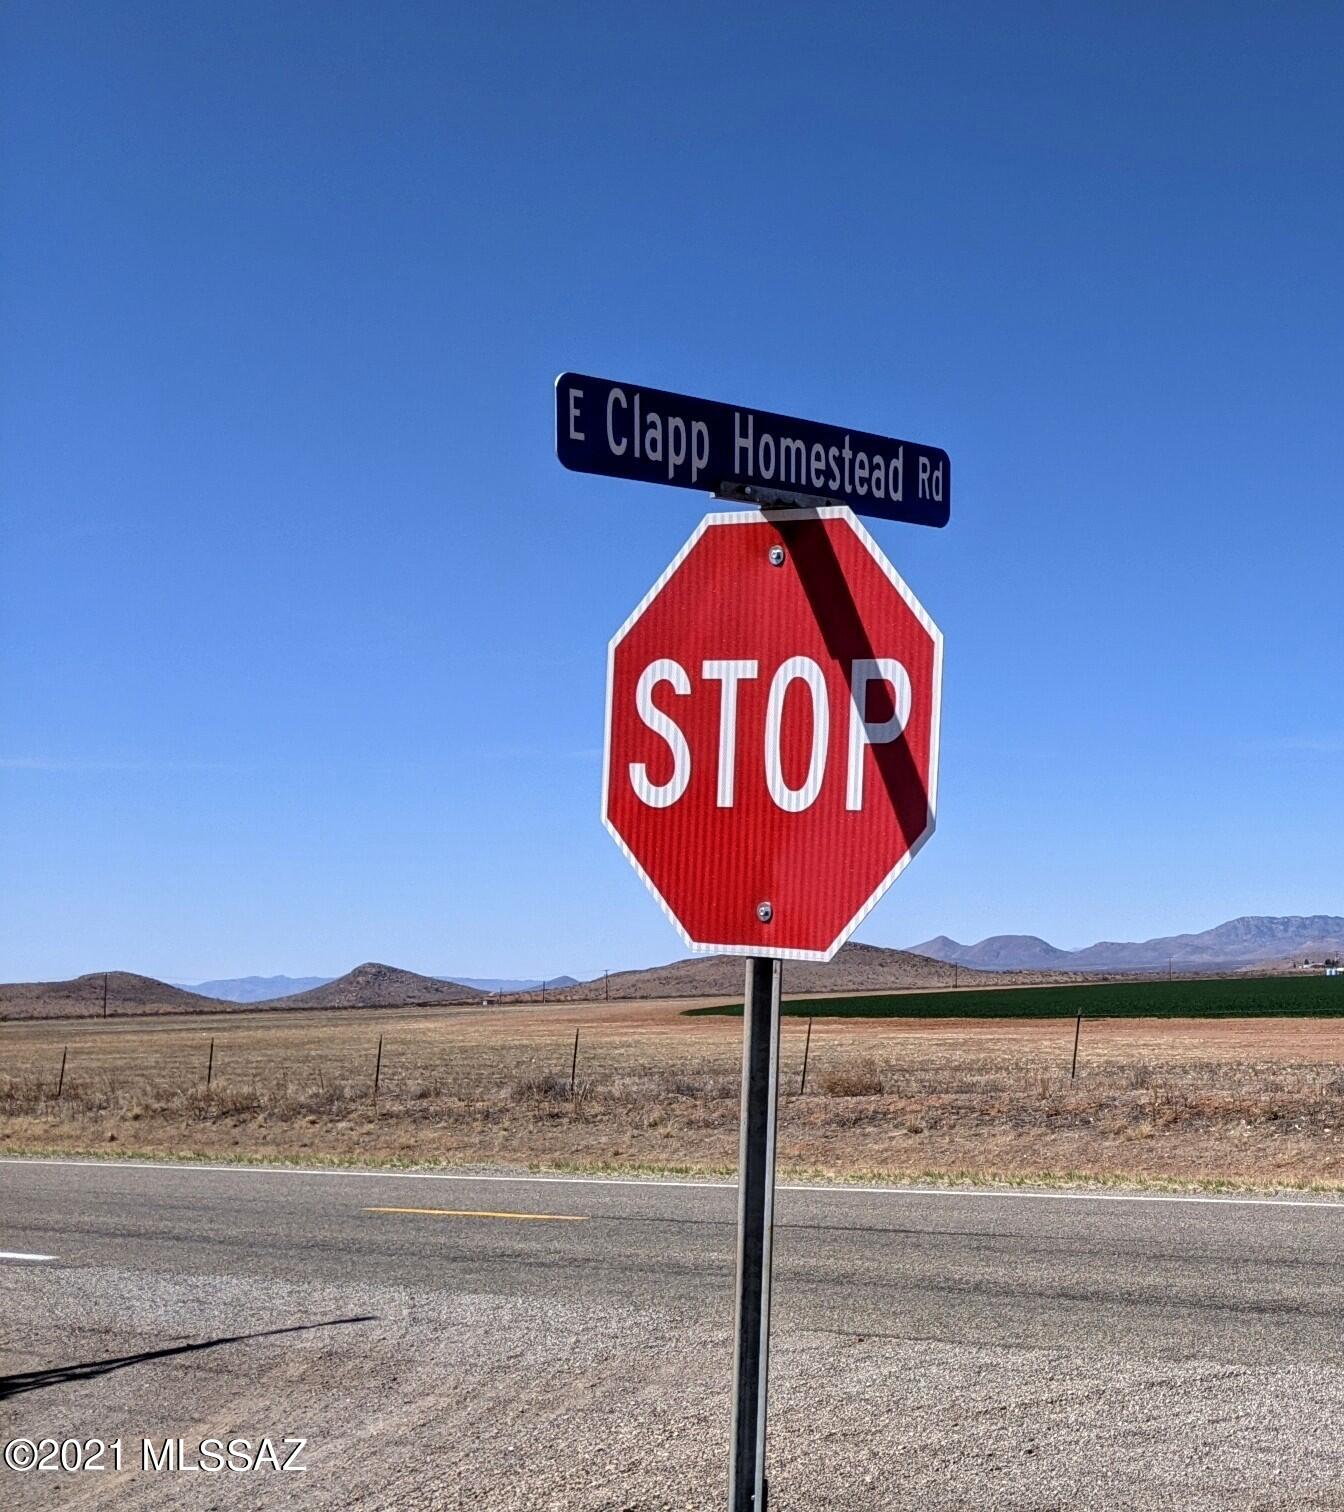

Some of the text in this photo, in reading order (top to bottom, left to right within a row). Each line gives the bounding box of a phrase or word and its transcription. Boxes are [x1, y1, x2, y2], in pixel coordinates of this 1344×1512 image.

[568, 387, 943, 502] E Clapp Homestead Rd
[628, 655, 912, 813] STOP
